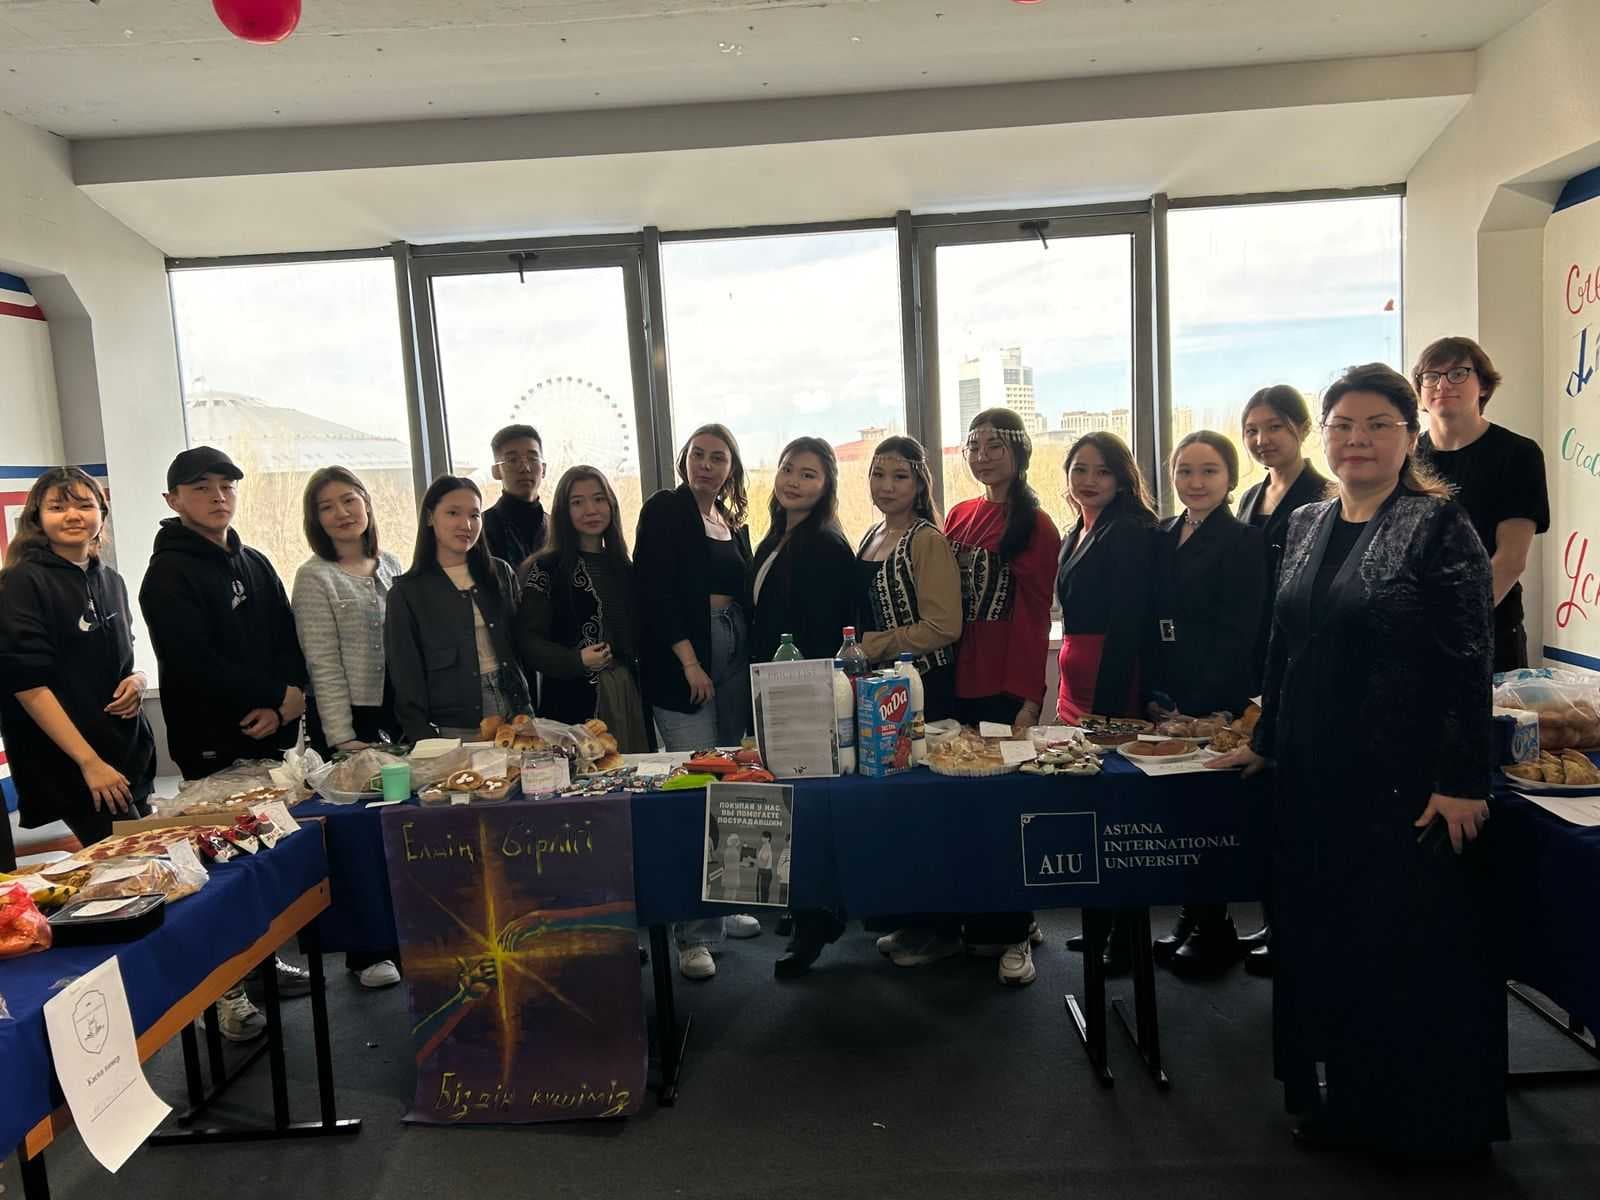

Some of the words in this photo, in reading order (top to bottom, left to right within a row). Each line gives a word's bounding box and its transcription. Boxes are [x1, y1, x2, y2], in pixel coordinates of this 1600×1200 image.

[879, 689, 908, 721] DaDa
[1103, 823, 1164, 836] ASTANA
[1103, 834, 1240, 853] INTERNATIONAL
[1039, 853, 1084, 875] AIU
[1104, 854, 1202, 869] UNIVERSITY
